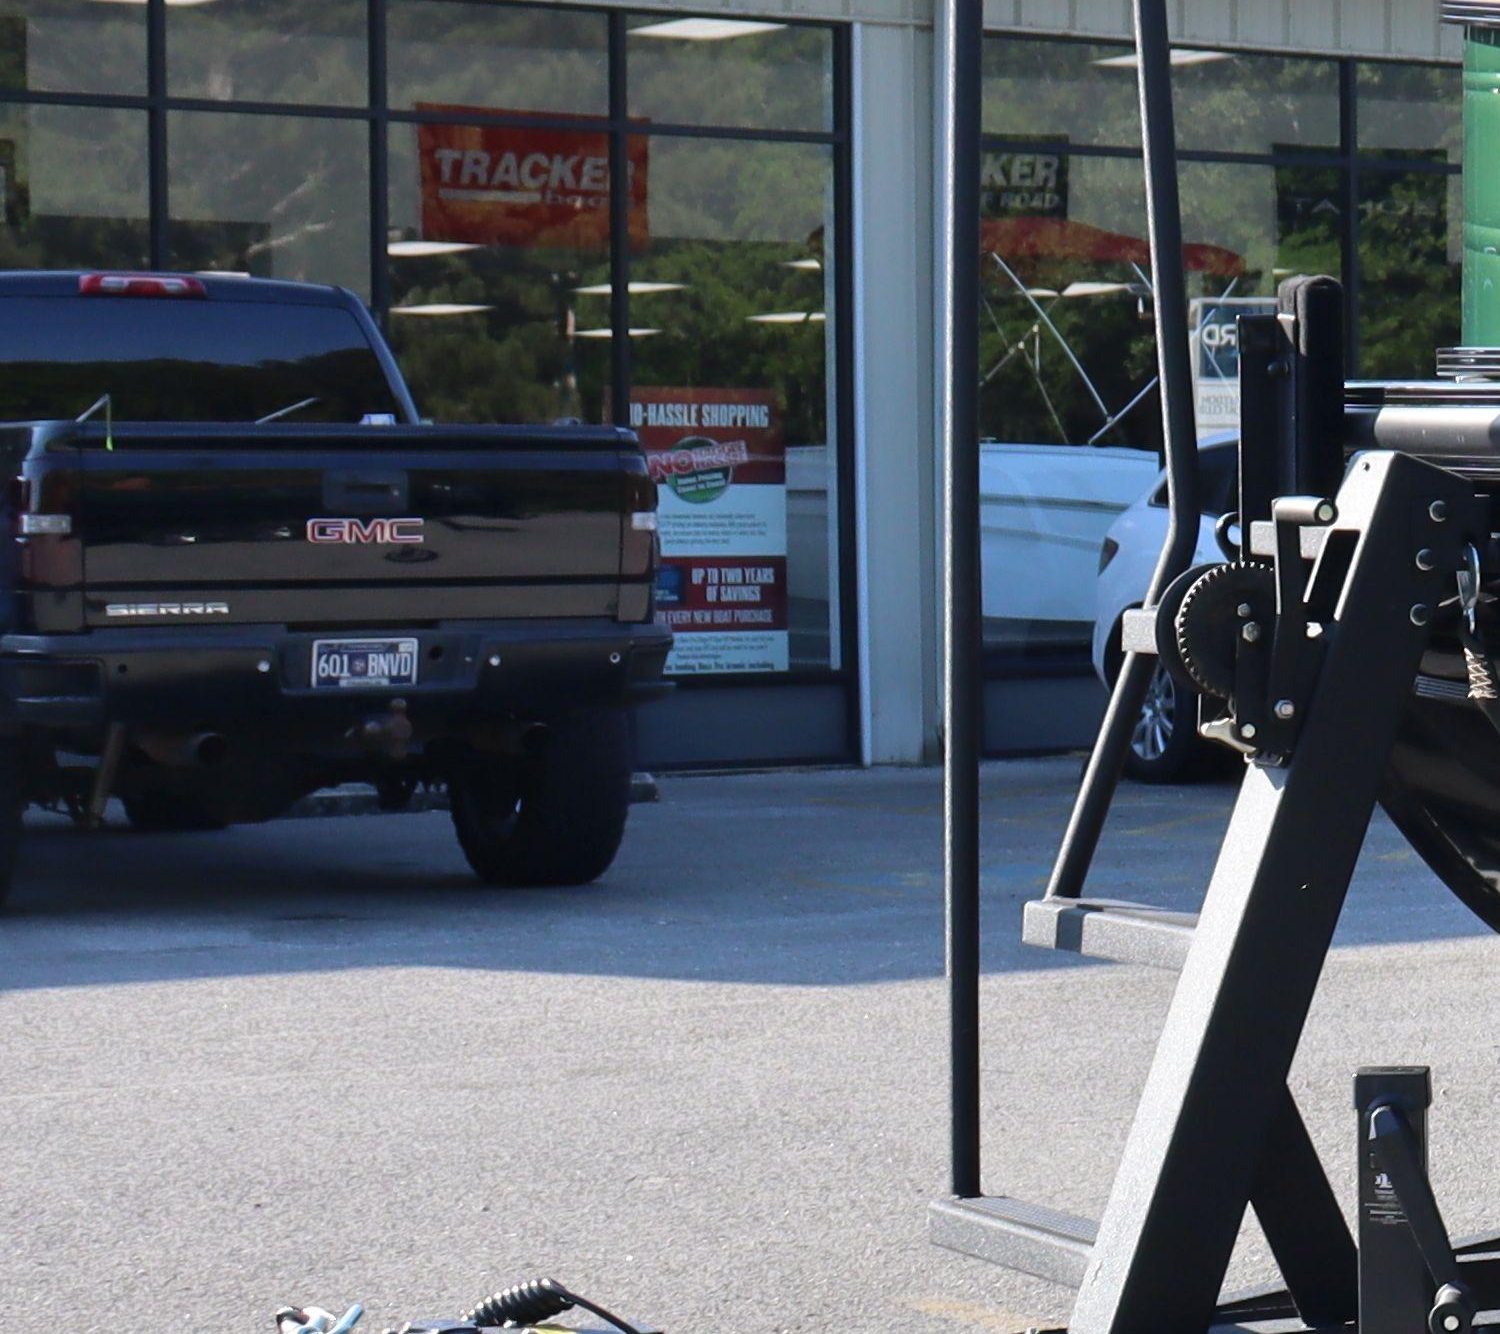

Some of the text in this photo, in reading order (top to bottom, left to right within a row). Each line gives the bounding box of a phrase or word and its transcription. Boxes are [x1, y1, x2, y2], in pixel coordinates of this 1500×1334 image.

[701, 402, 770, 428] SHOPPING
[306, 517, 424, 544] GMC
[691, 567, 776, 585] UP TO TWO YEARS
[705, 585, 762, 603] OF SAVINGS
[105, 601, 230, 617] SIERRA
[667, 609, 692, 624] EVERY
[693, 609, 712, 624] NEW
[734, 609, 774, 624] PURCHASE
[318, 653, 352, 678] 601
